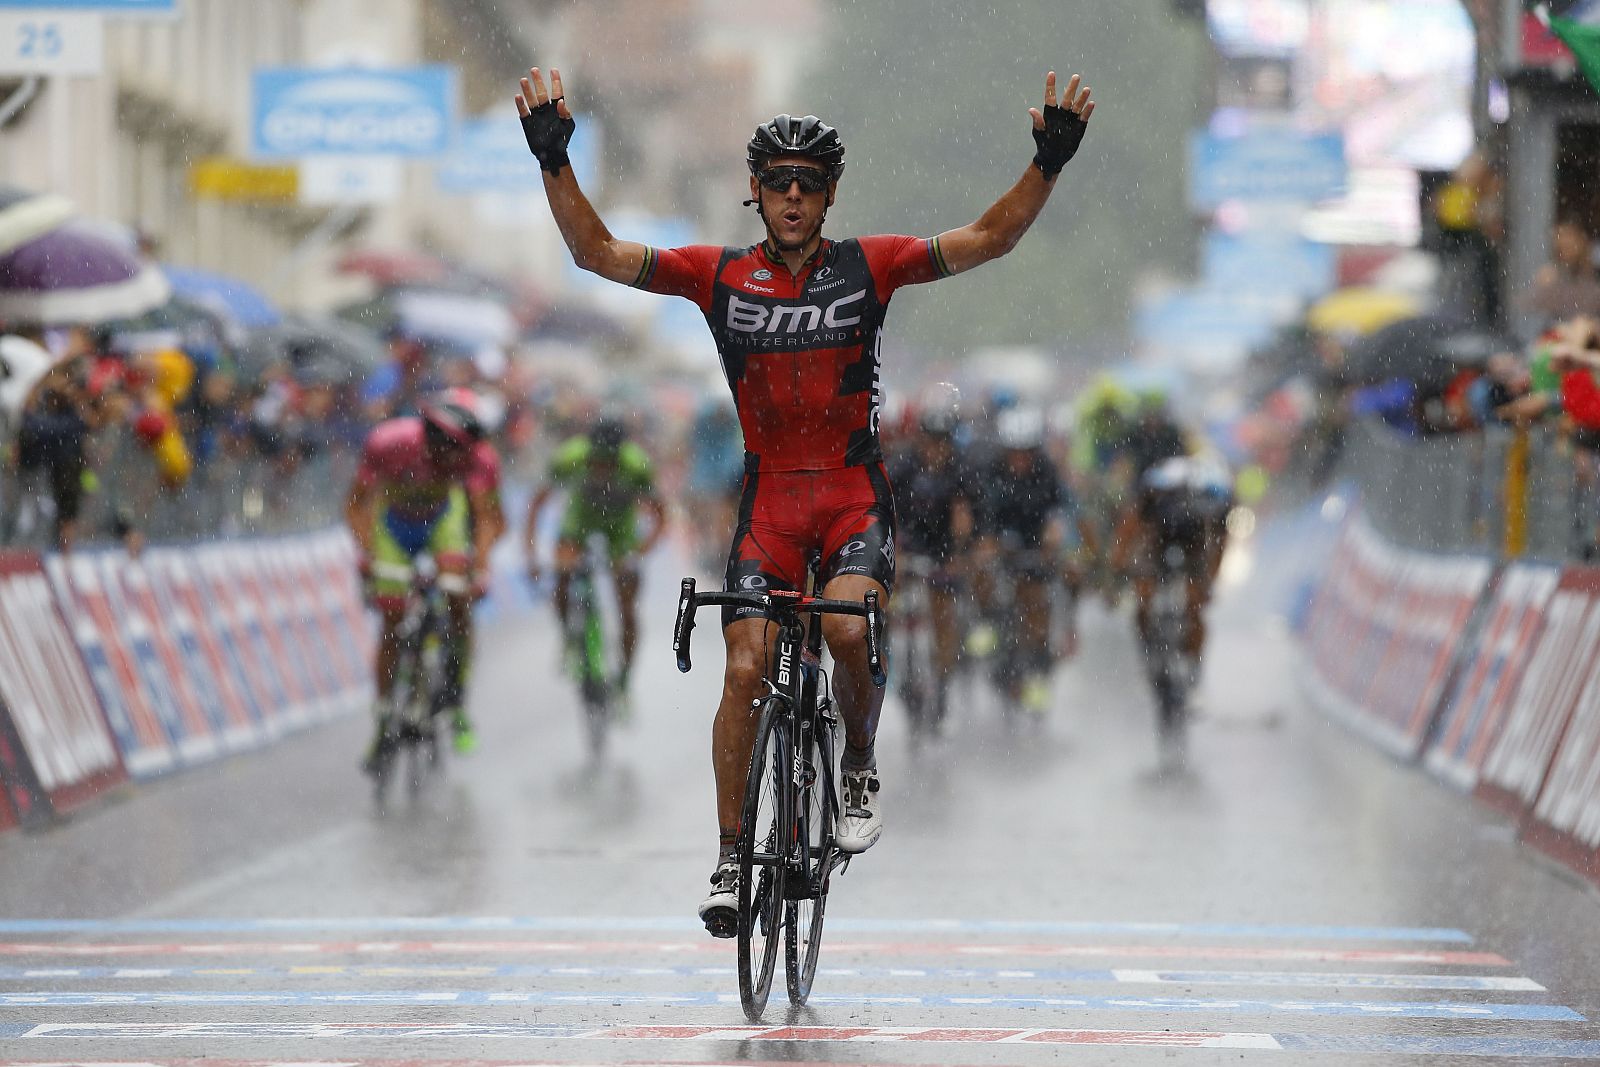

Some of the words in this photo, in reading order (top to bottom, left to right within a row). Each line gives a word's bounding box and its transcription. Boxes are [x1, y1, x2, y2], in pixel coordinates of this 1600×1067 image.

[17, 21, 63, 58] 25
[743, 280, 775, 293] impec
[808, 278, 845, 294] SHIMANO
[726, 289, 867, 333] BMC
[728, 331, 848, 347] SWITZERLAND
[777, 642, 793, 686] BMC
[792, 746, 803, 785] BMC
